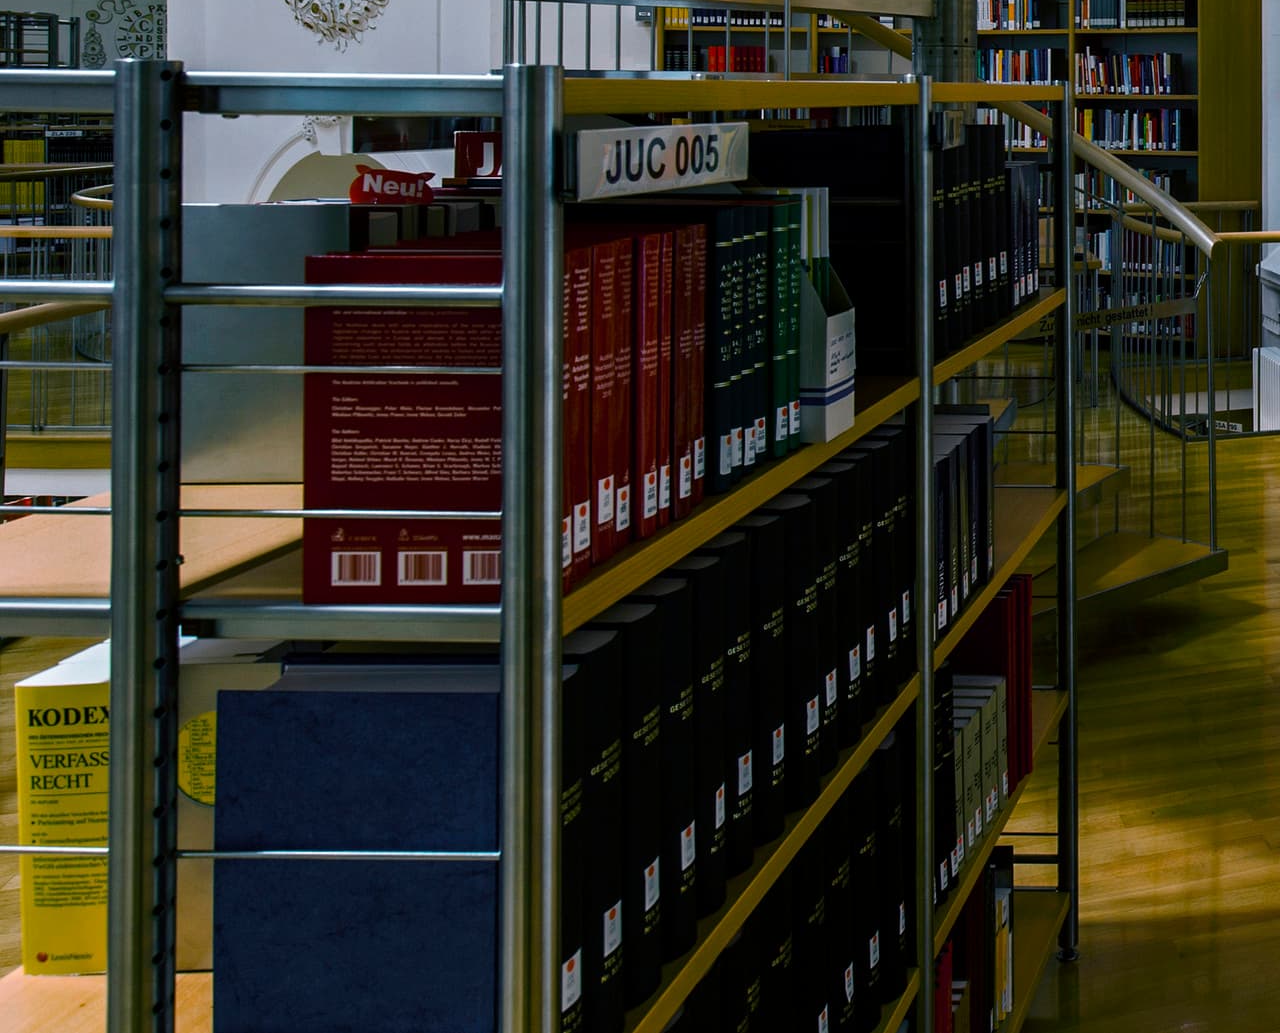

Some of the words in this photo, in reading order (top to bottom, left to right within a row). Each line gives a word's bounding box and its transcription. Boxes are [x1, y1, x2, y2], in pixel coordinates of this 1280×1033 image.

[605, 137, 667, 185] JUC
[675, 133, 720, 178] 005
[362, 172, 425, 200] Neu!
[31, 773, 93, 791] RECHT
